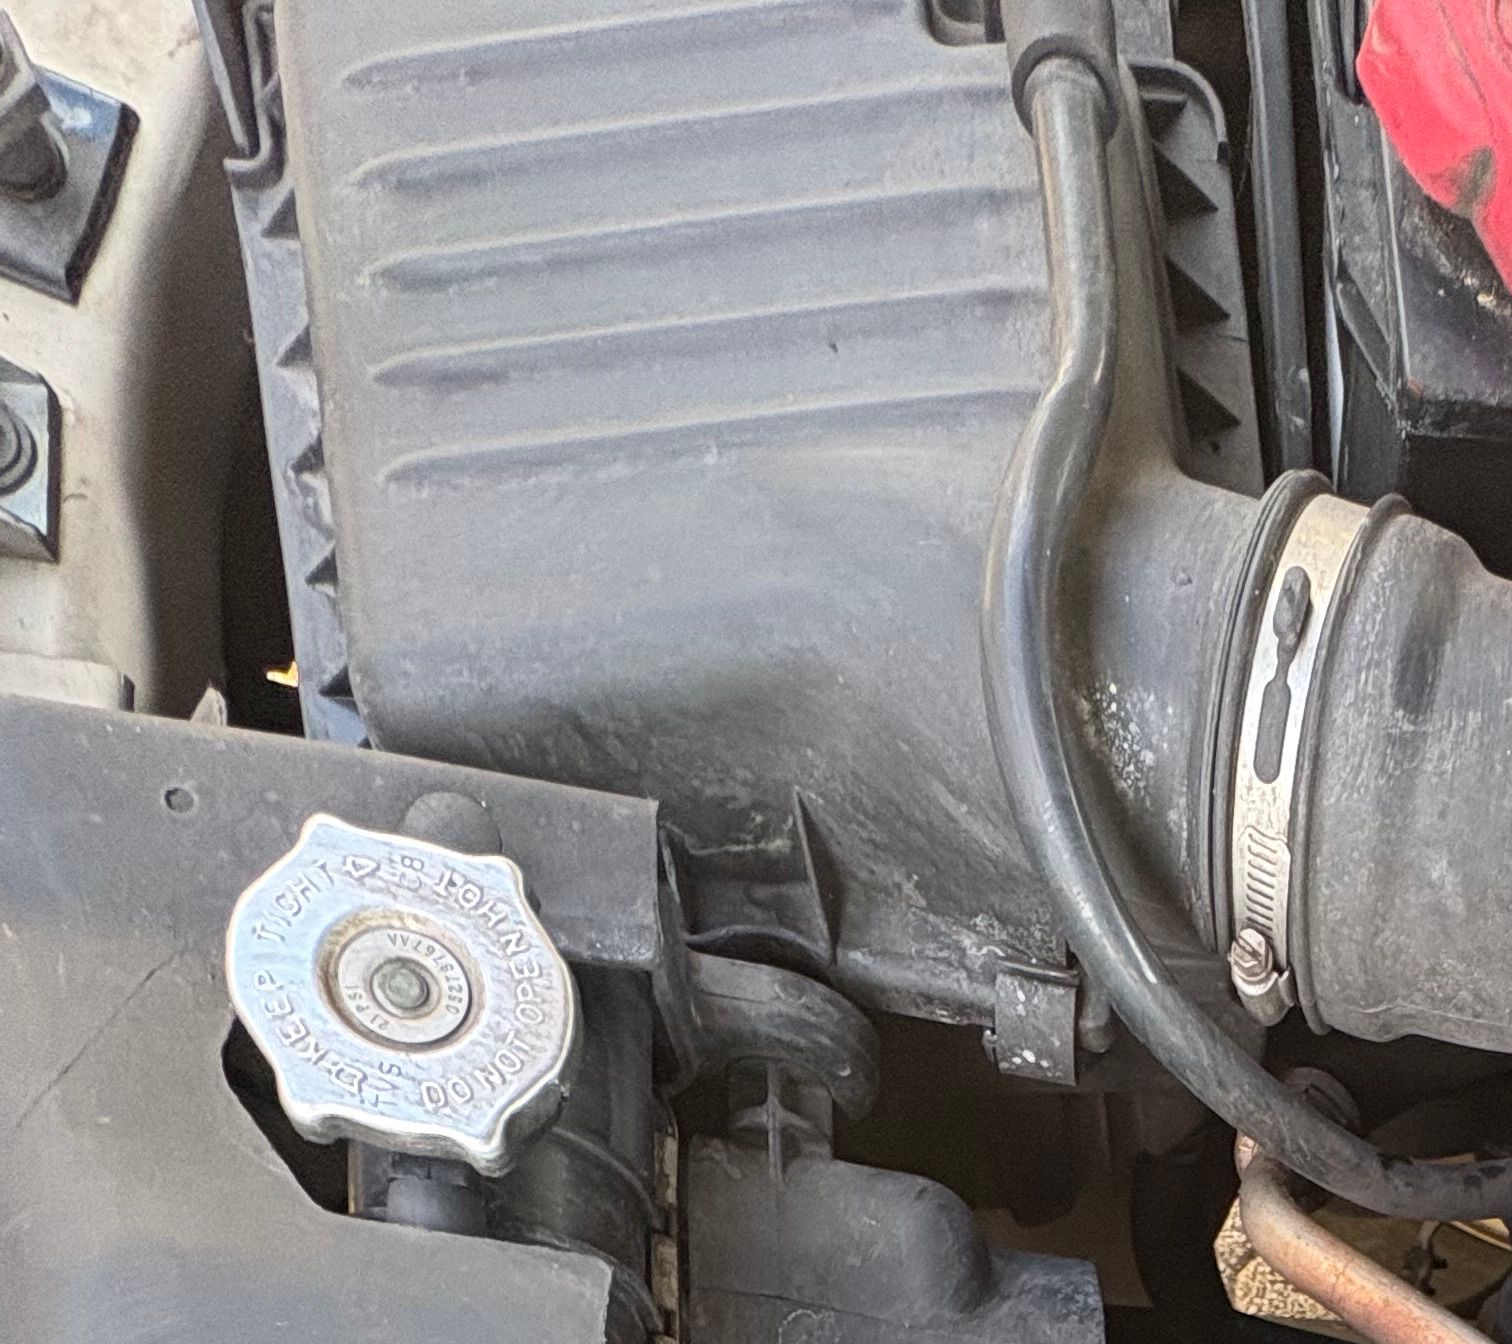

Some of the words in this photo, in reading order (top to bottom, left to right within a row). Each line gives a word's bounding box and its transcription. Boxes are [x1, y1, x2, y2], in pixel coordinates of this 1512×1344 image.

[252, 860, 334, 942] TIGHT
[434, 872, 509, 929] HOT
[344, 985, 370, 1013] PSI
[501, 929, 546, 1025] OPEN
[251, 968, 328, 1067] KEEP
[370, 1014, 390, 1030] 21
[474, 1029, 533, 1093] NOT
[420, 1078, 476, 1112] DO
